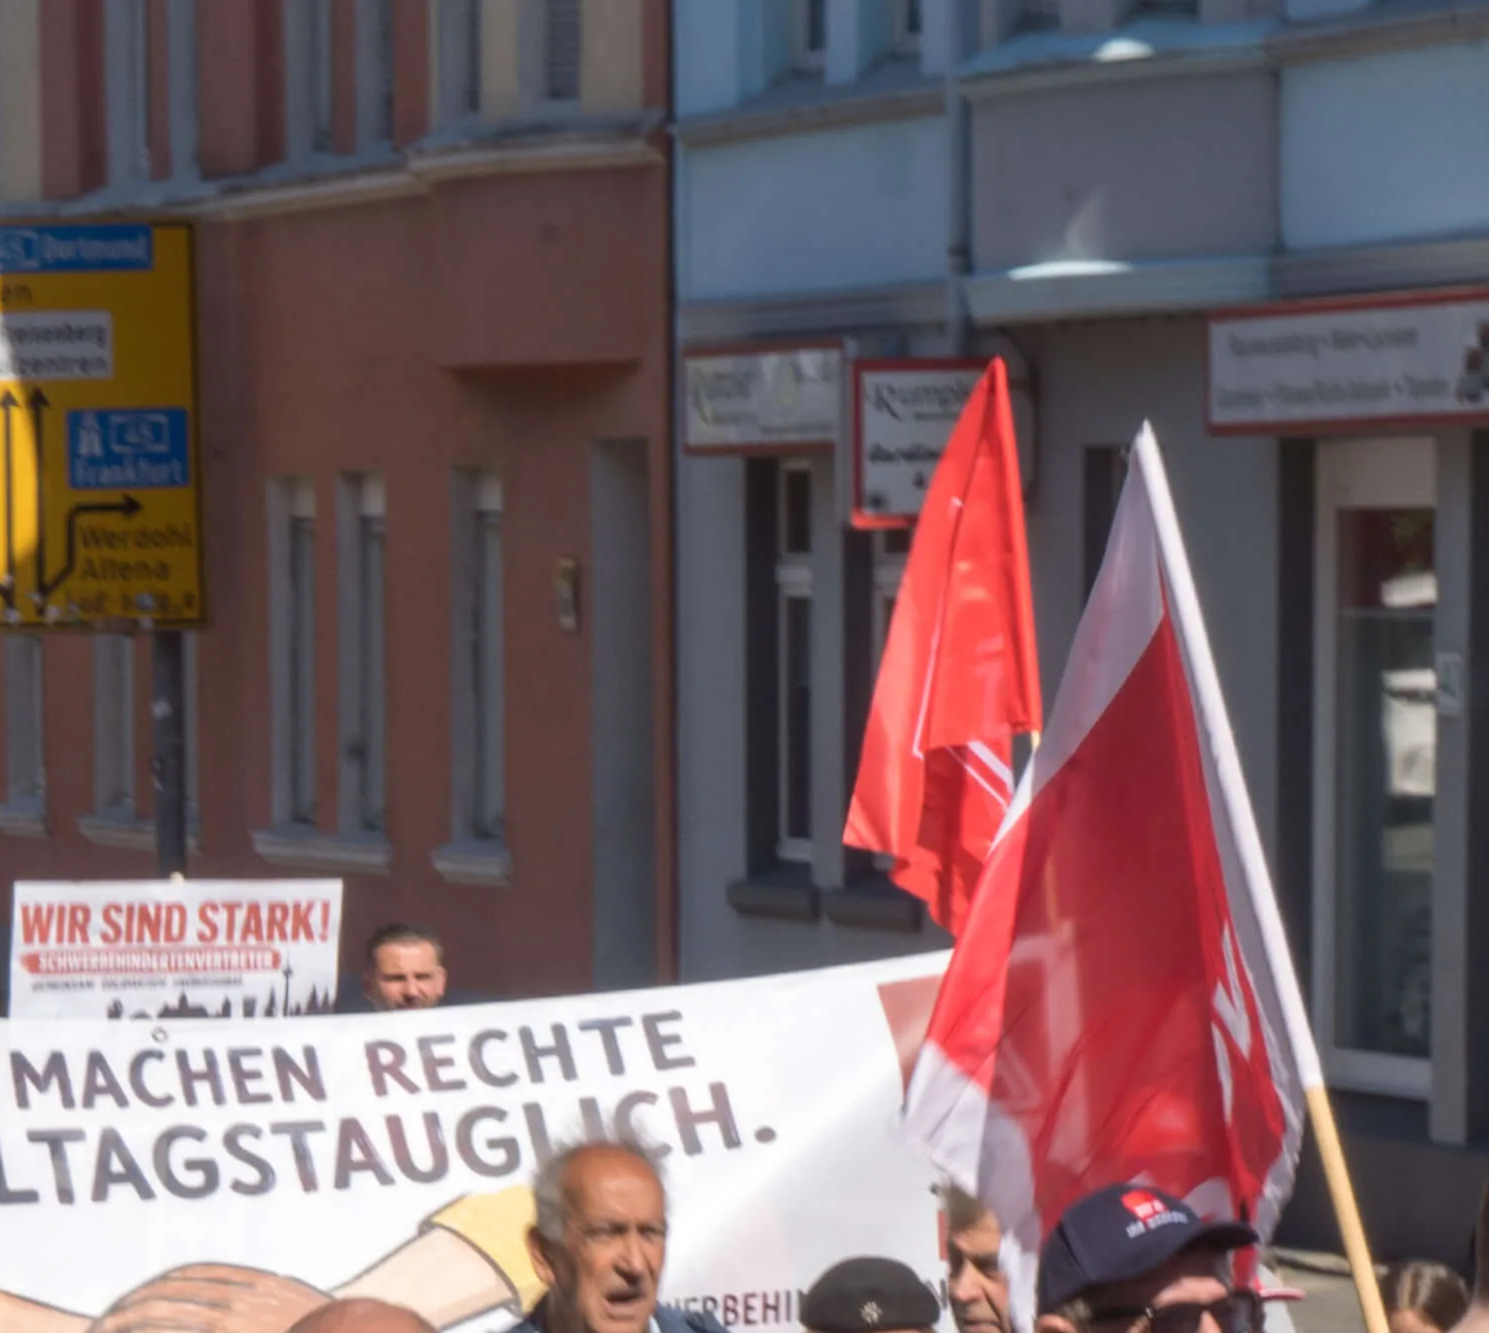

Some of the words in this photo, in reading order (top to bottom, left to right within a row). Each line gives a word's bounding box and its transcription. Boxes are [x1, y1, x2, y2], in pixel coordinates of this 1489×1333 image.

[21, 902, 91, 944] WIR
[100, 901, 187, 943] SIND
[196, 899, 330, 942] STARK!
[10, 1043, 326, 1112] MACHEN
[365, 1009, 697, 1100] RECHTE
